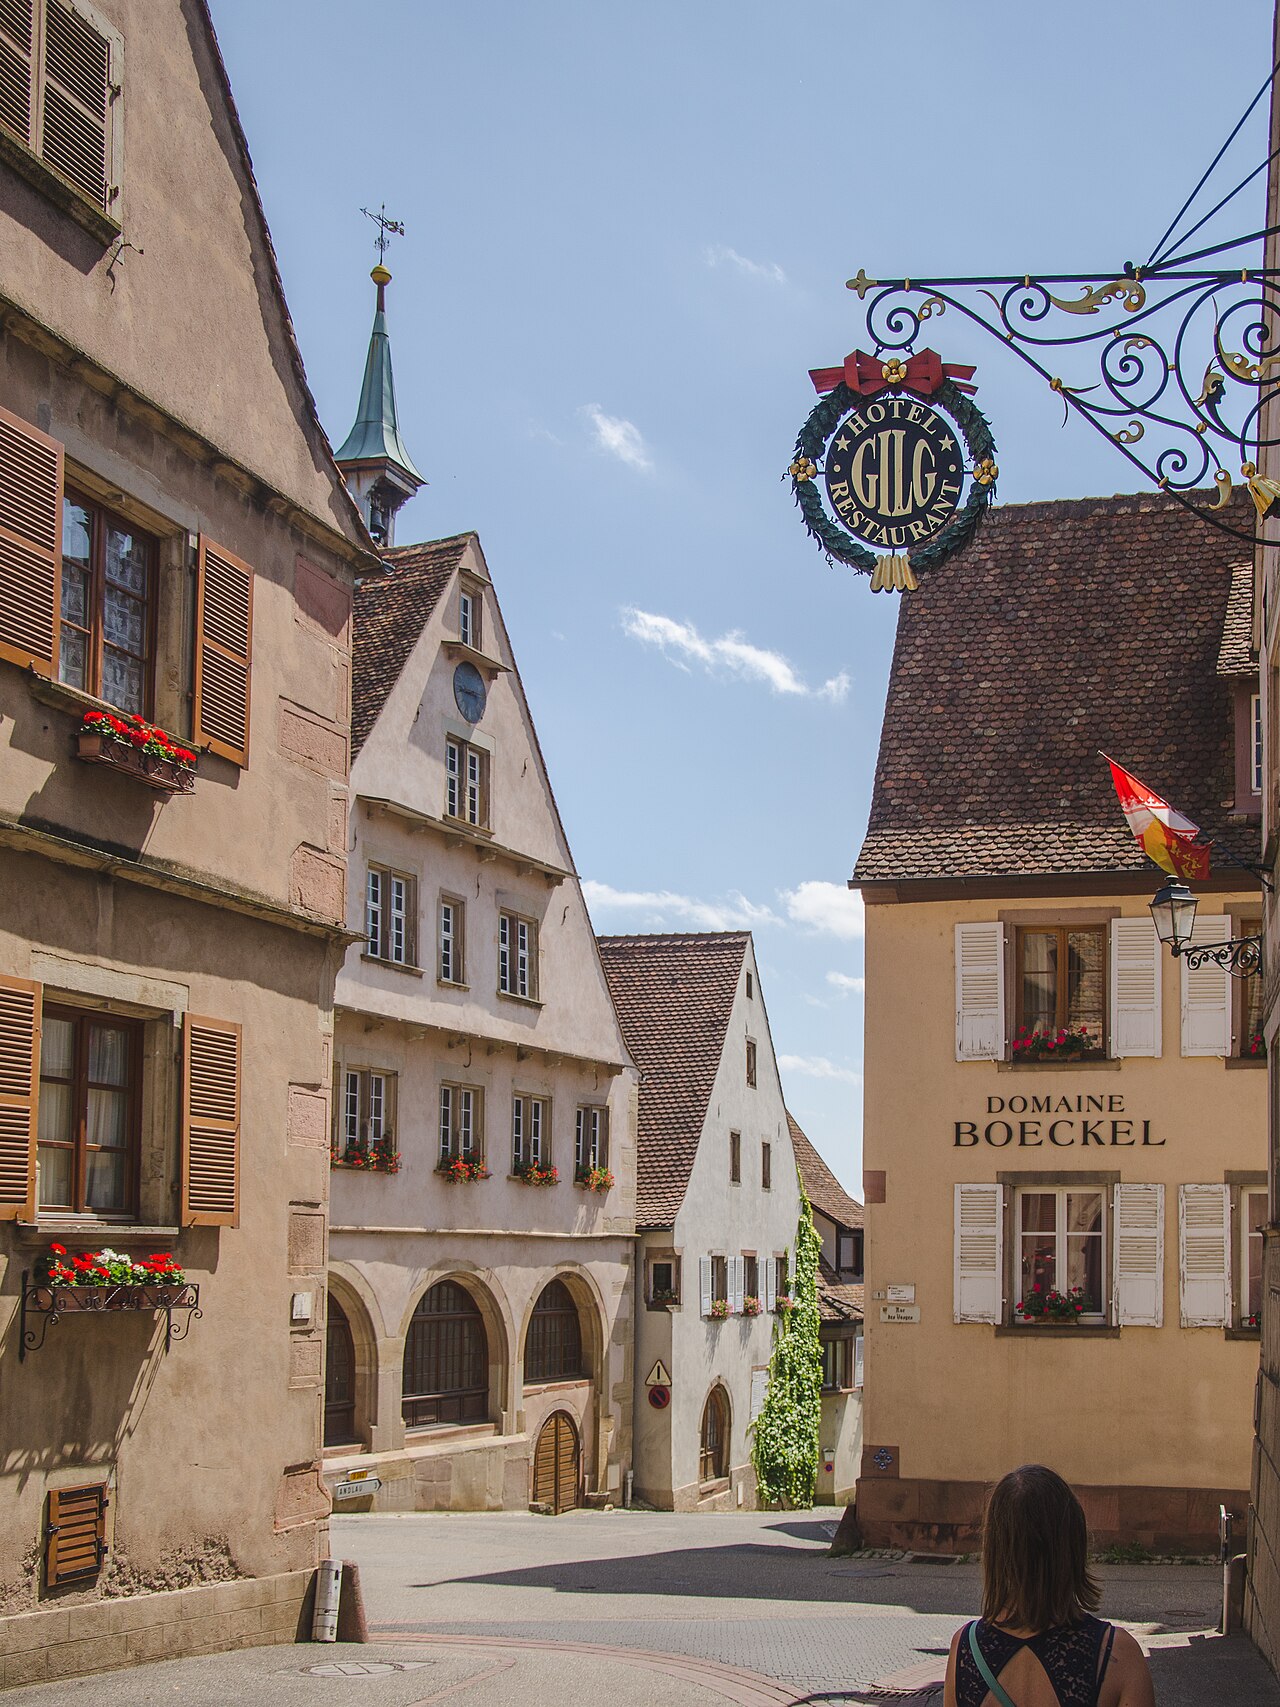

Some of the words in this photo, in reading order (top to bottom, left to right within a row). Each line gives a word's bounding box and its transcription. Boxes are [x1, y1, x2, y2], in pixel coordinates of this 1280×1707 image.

[845, 400, 939, 437] HOTEL
[851, 429, 937, 517] GILG
[829, 479, 960, 545] RESTAURANT
[986, 1095, 1126, 1114] DOMAINE
[953, 1120, 1167, 1148] BOECKEL
[339, 1485, 363, 1495] ANDLAU
